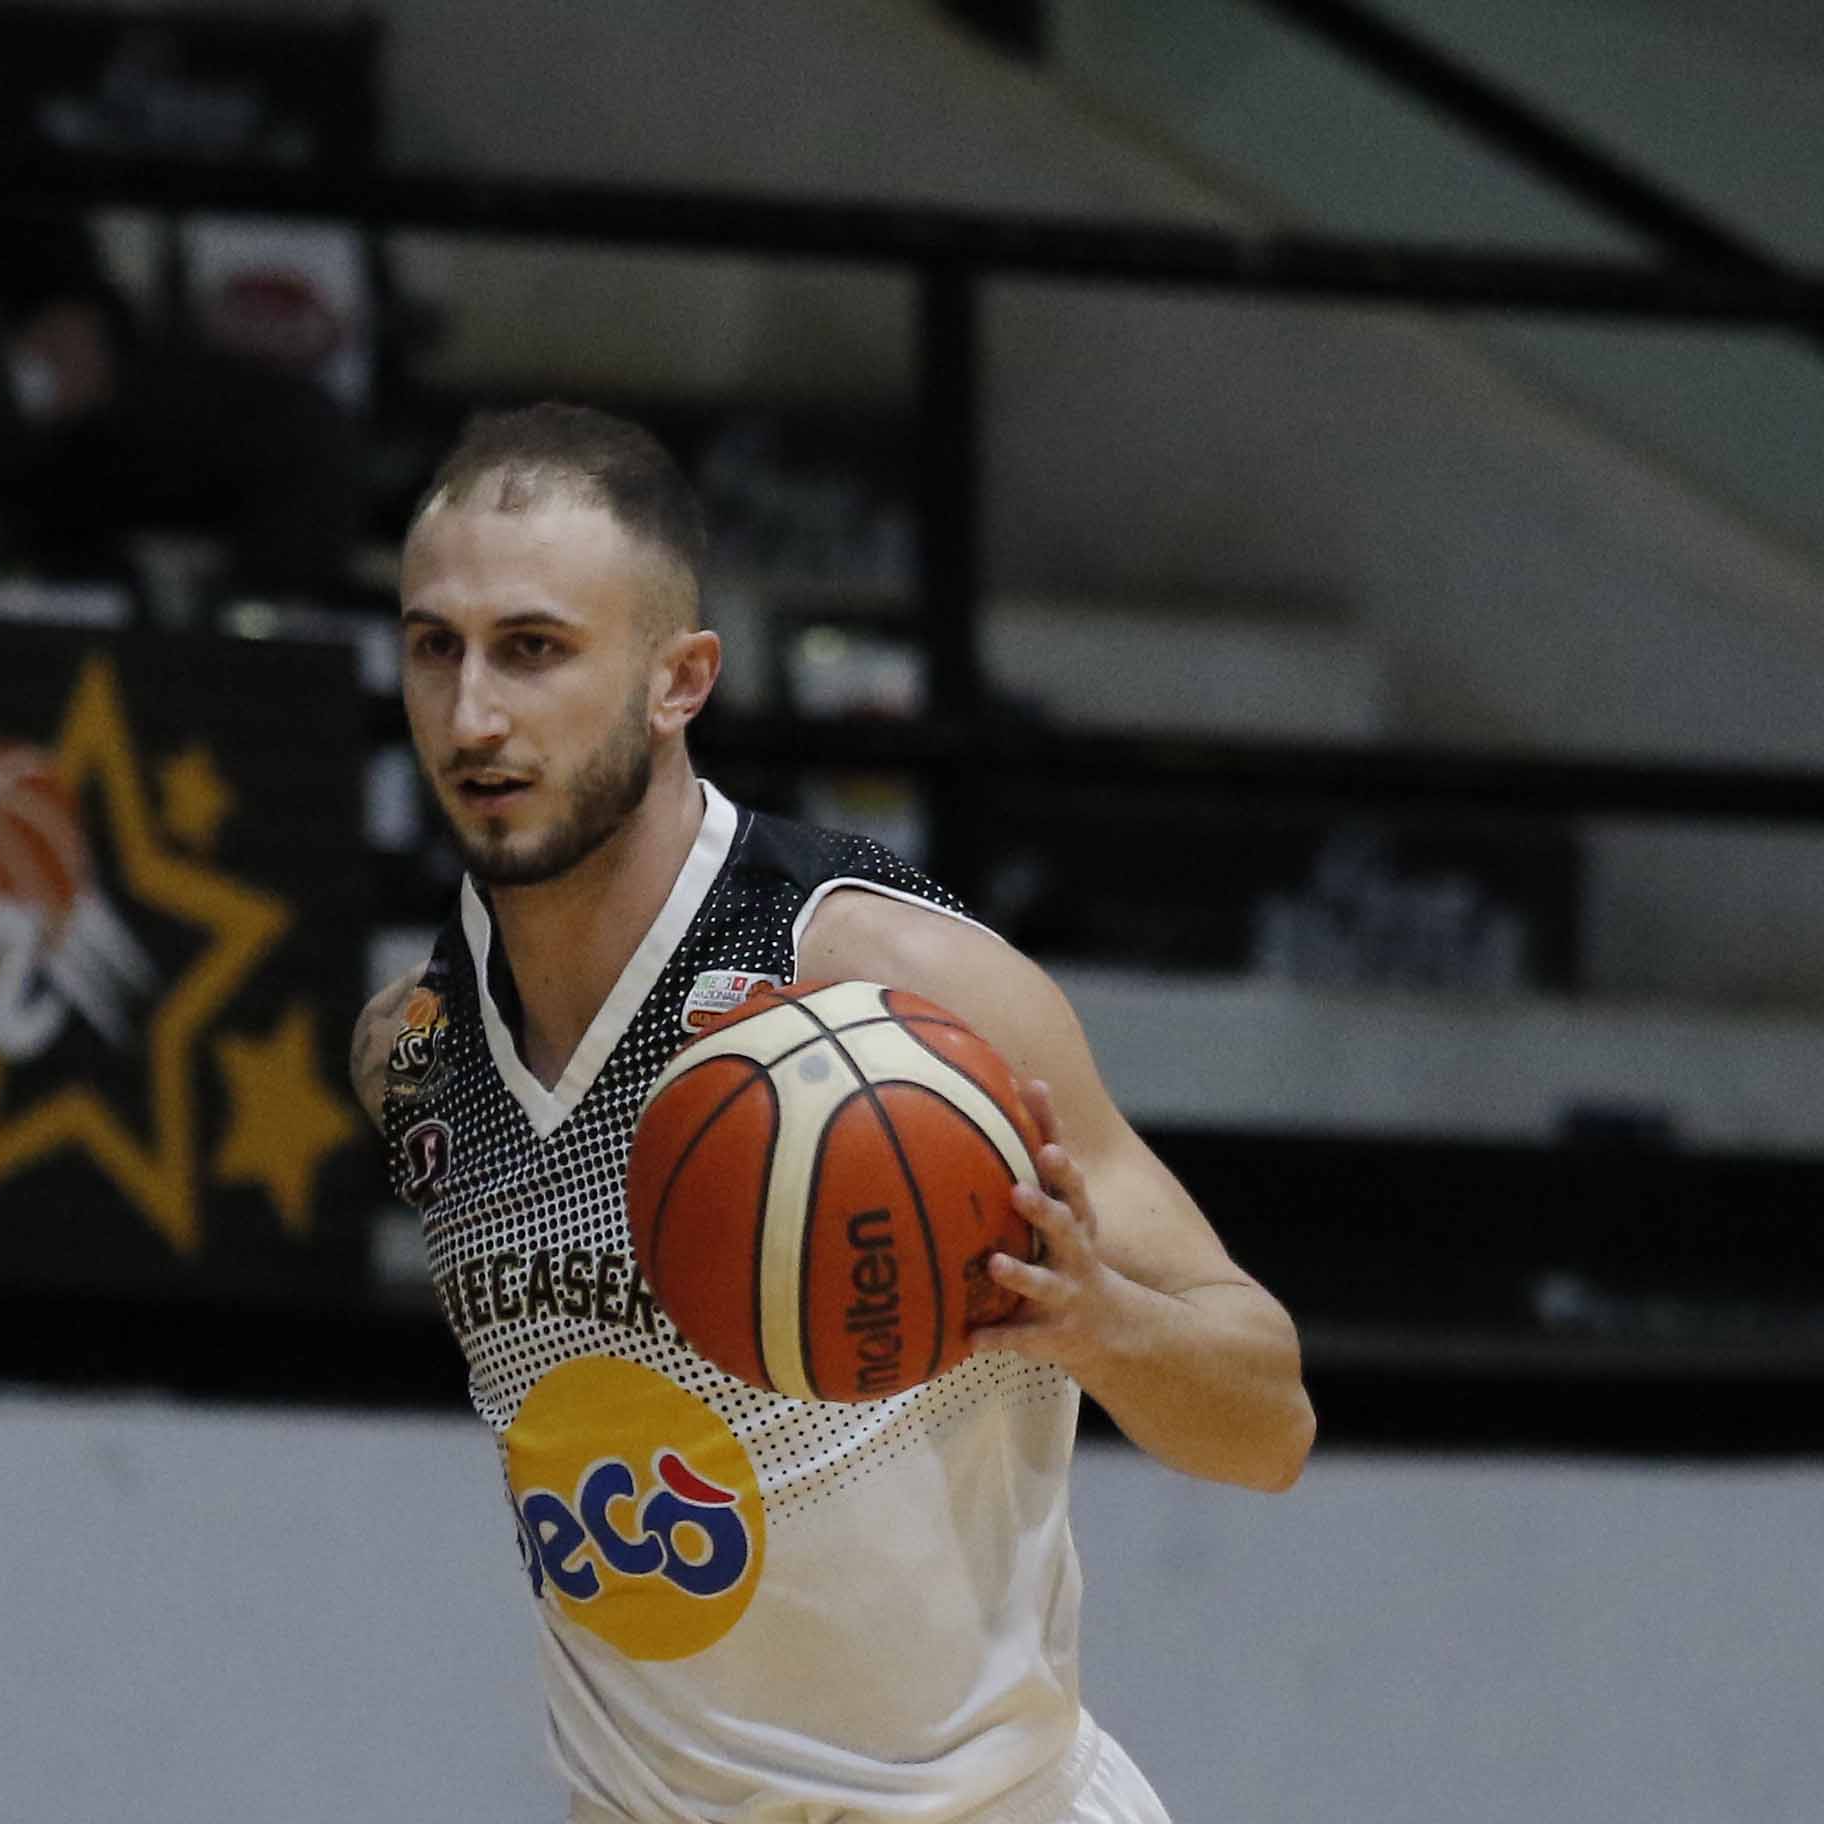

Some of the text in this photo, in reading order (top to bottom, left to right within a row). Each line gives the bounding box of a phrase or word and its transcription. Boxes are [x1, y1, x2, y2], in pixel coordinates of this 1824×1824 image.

[391, 1036, 428, 1071] JC
[844, 1207, 904, 1394] molten
[522, 1449, 752, 1602] ecò
